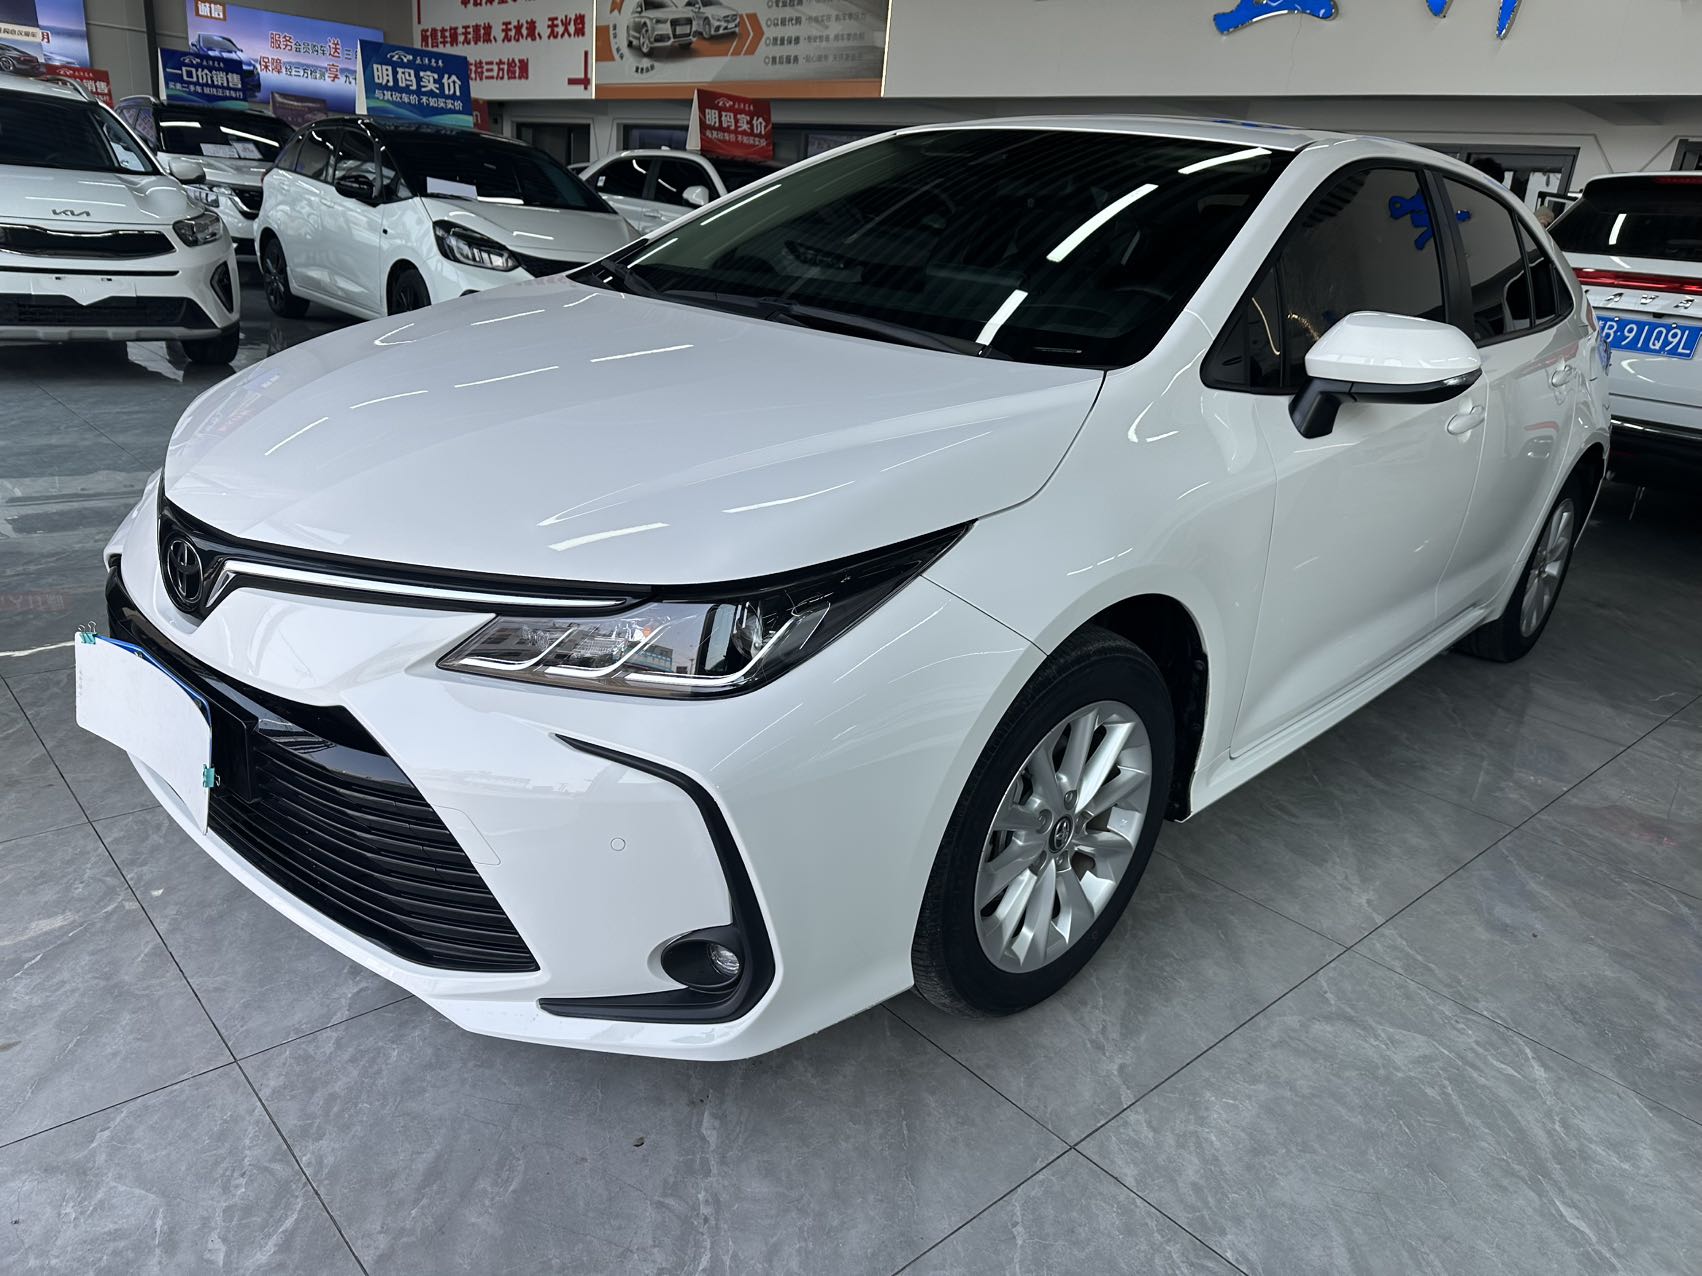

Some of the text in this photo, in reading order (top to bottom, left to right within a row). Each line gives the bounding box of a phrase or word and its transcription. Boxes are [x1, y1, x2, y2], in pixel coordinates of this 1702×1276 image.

[166, 66, 242, 88] 一口价销售
[373, 63, 461, 96] 明码实价
[705, 108, 766, 135] 明码实价
[1585, 289, 1695, 309] AVA
